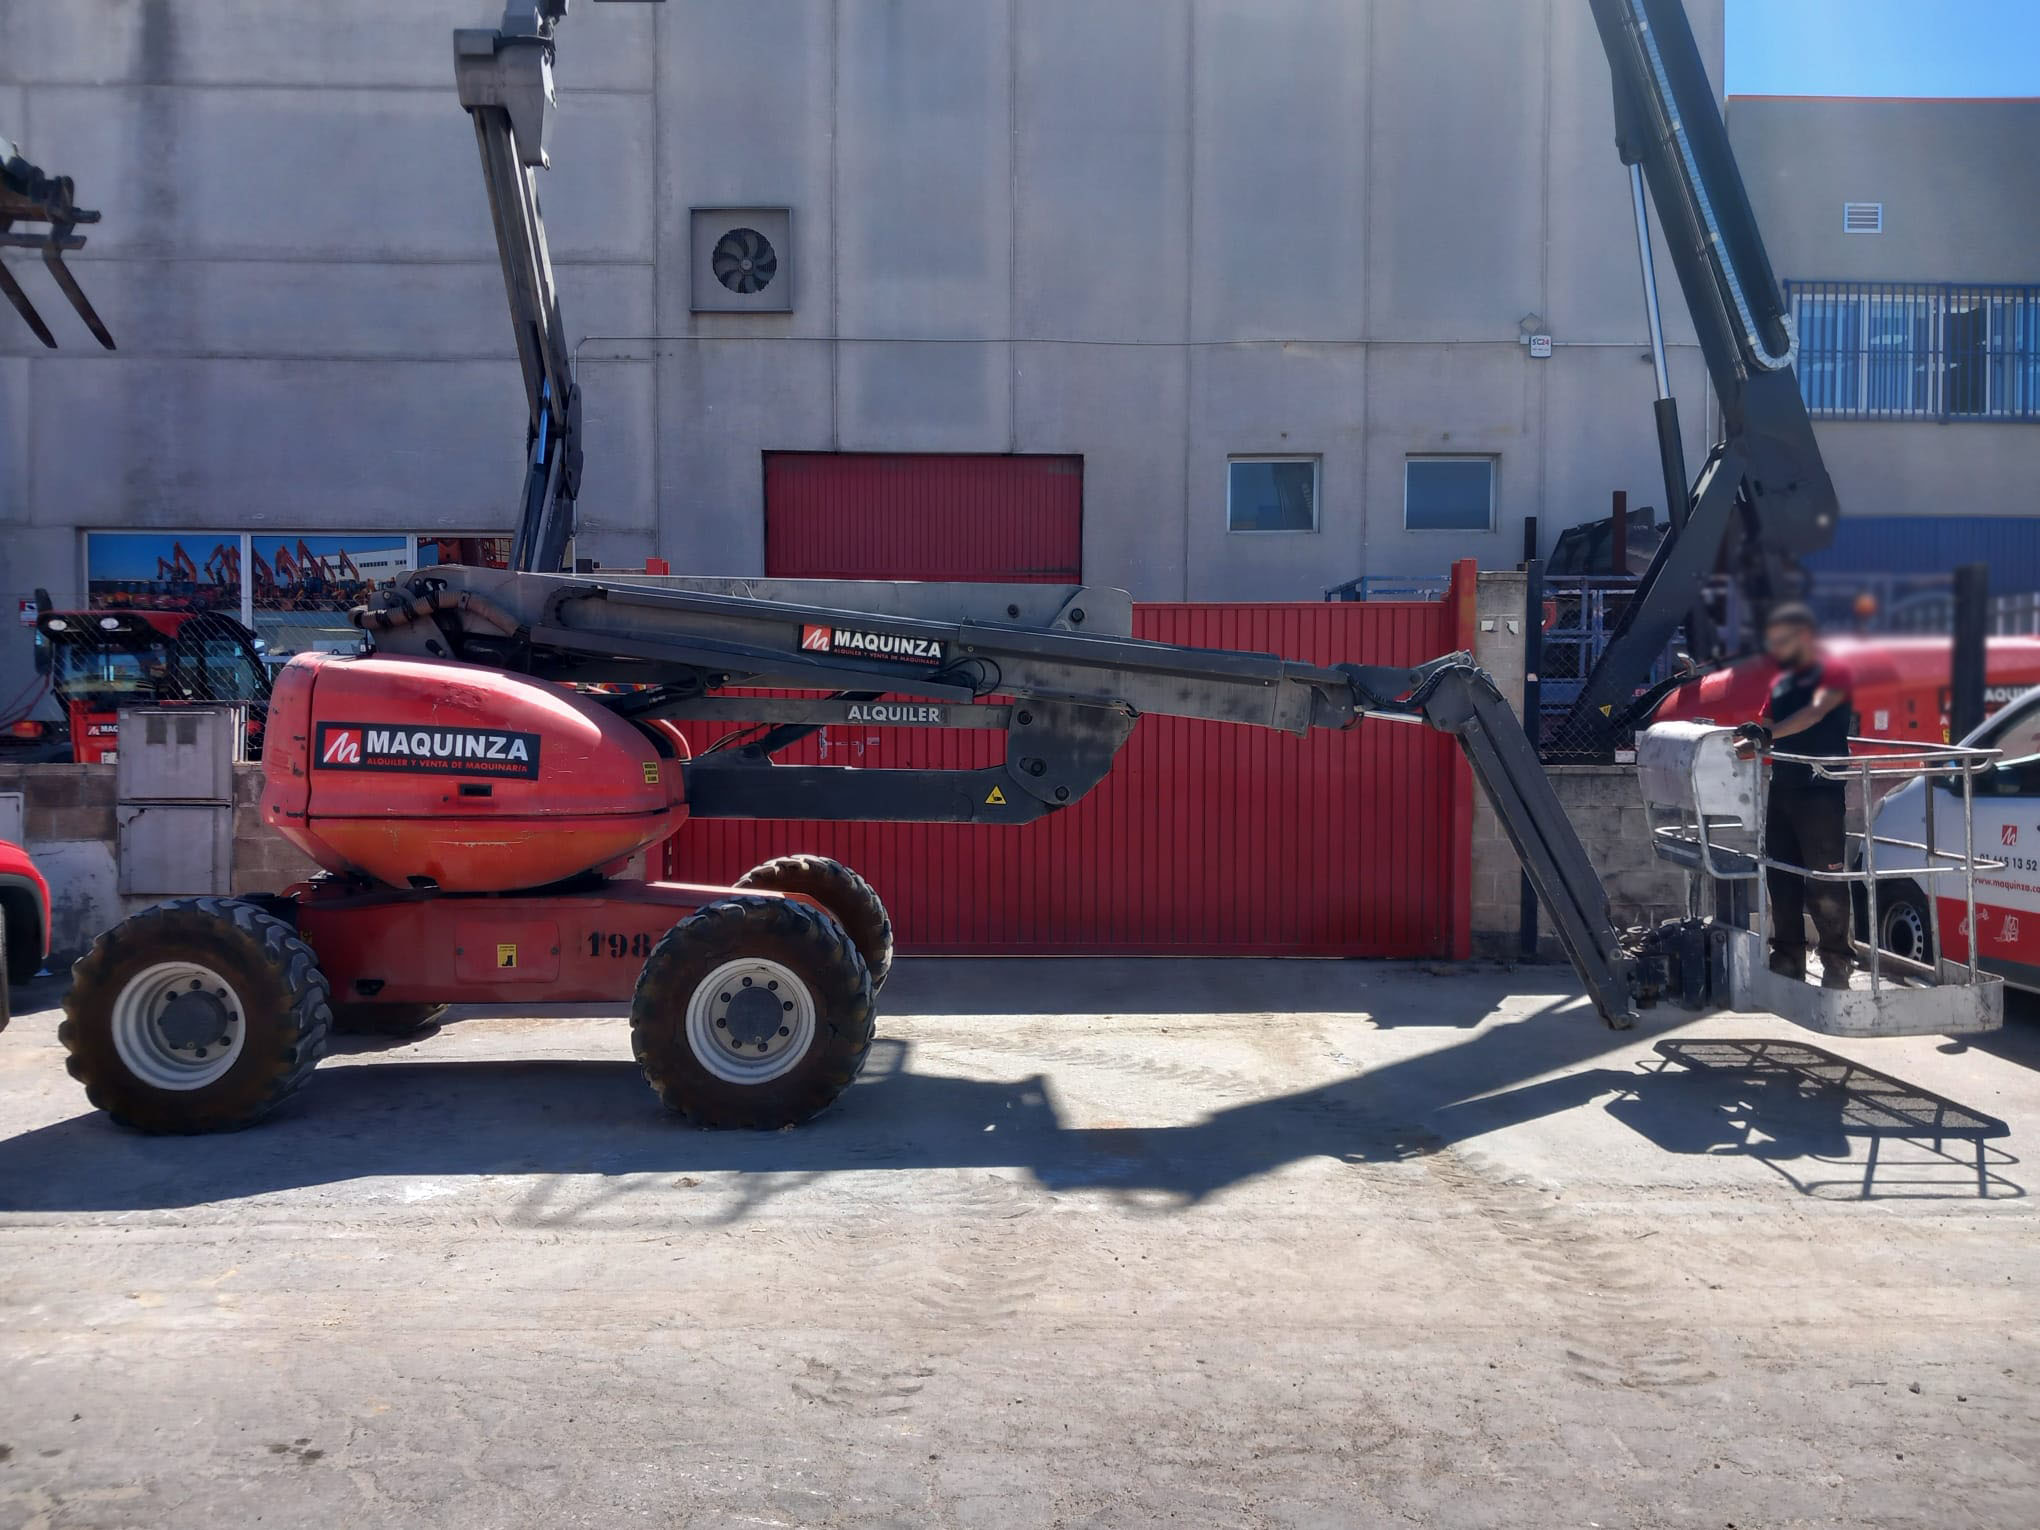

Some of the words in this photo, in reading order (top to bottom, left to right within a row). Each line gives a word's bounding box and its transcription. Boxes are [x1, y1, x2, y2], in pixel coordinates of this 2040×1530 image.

[834, 630, 942, 658] MAQUINZA
[833, 648, 862, 656] ALQUILER
[870, 652, 889, 660] VENTA
[847, 705, 940, 722] ALQUILER
[366, 730, 529, 761] MAQUINZA
[366, 757, 408, 767] ALQUILER
[411, 759, 417, 767] Y
[420, 759, 449, 768] VENTA
[451, 761, 463, 769] DE
[465, 761, 528, 772] MAQUINARIA
[2012, 858, 2023, 869] 13
[2026, 859, 2038, 871] 52
